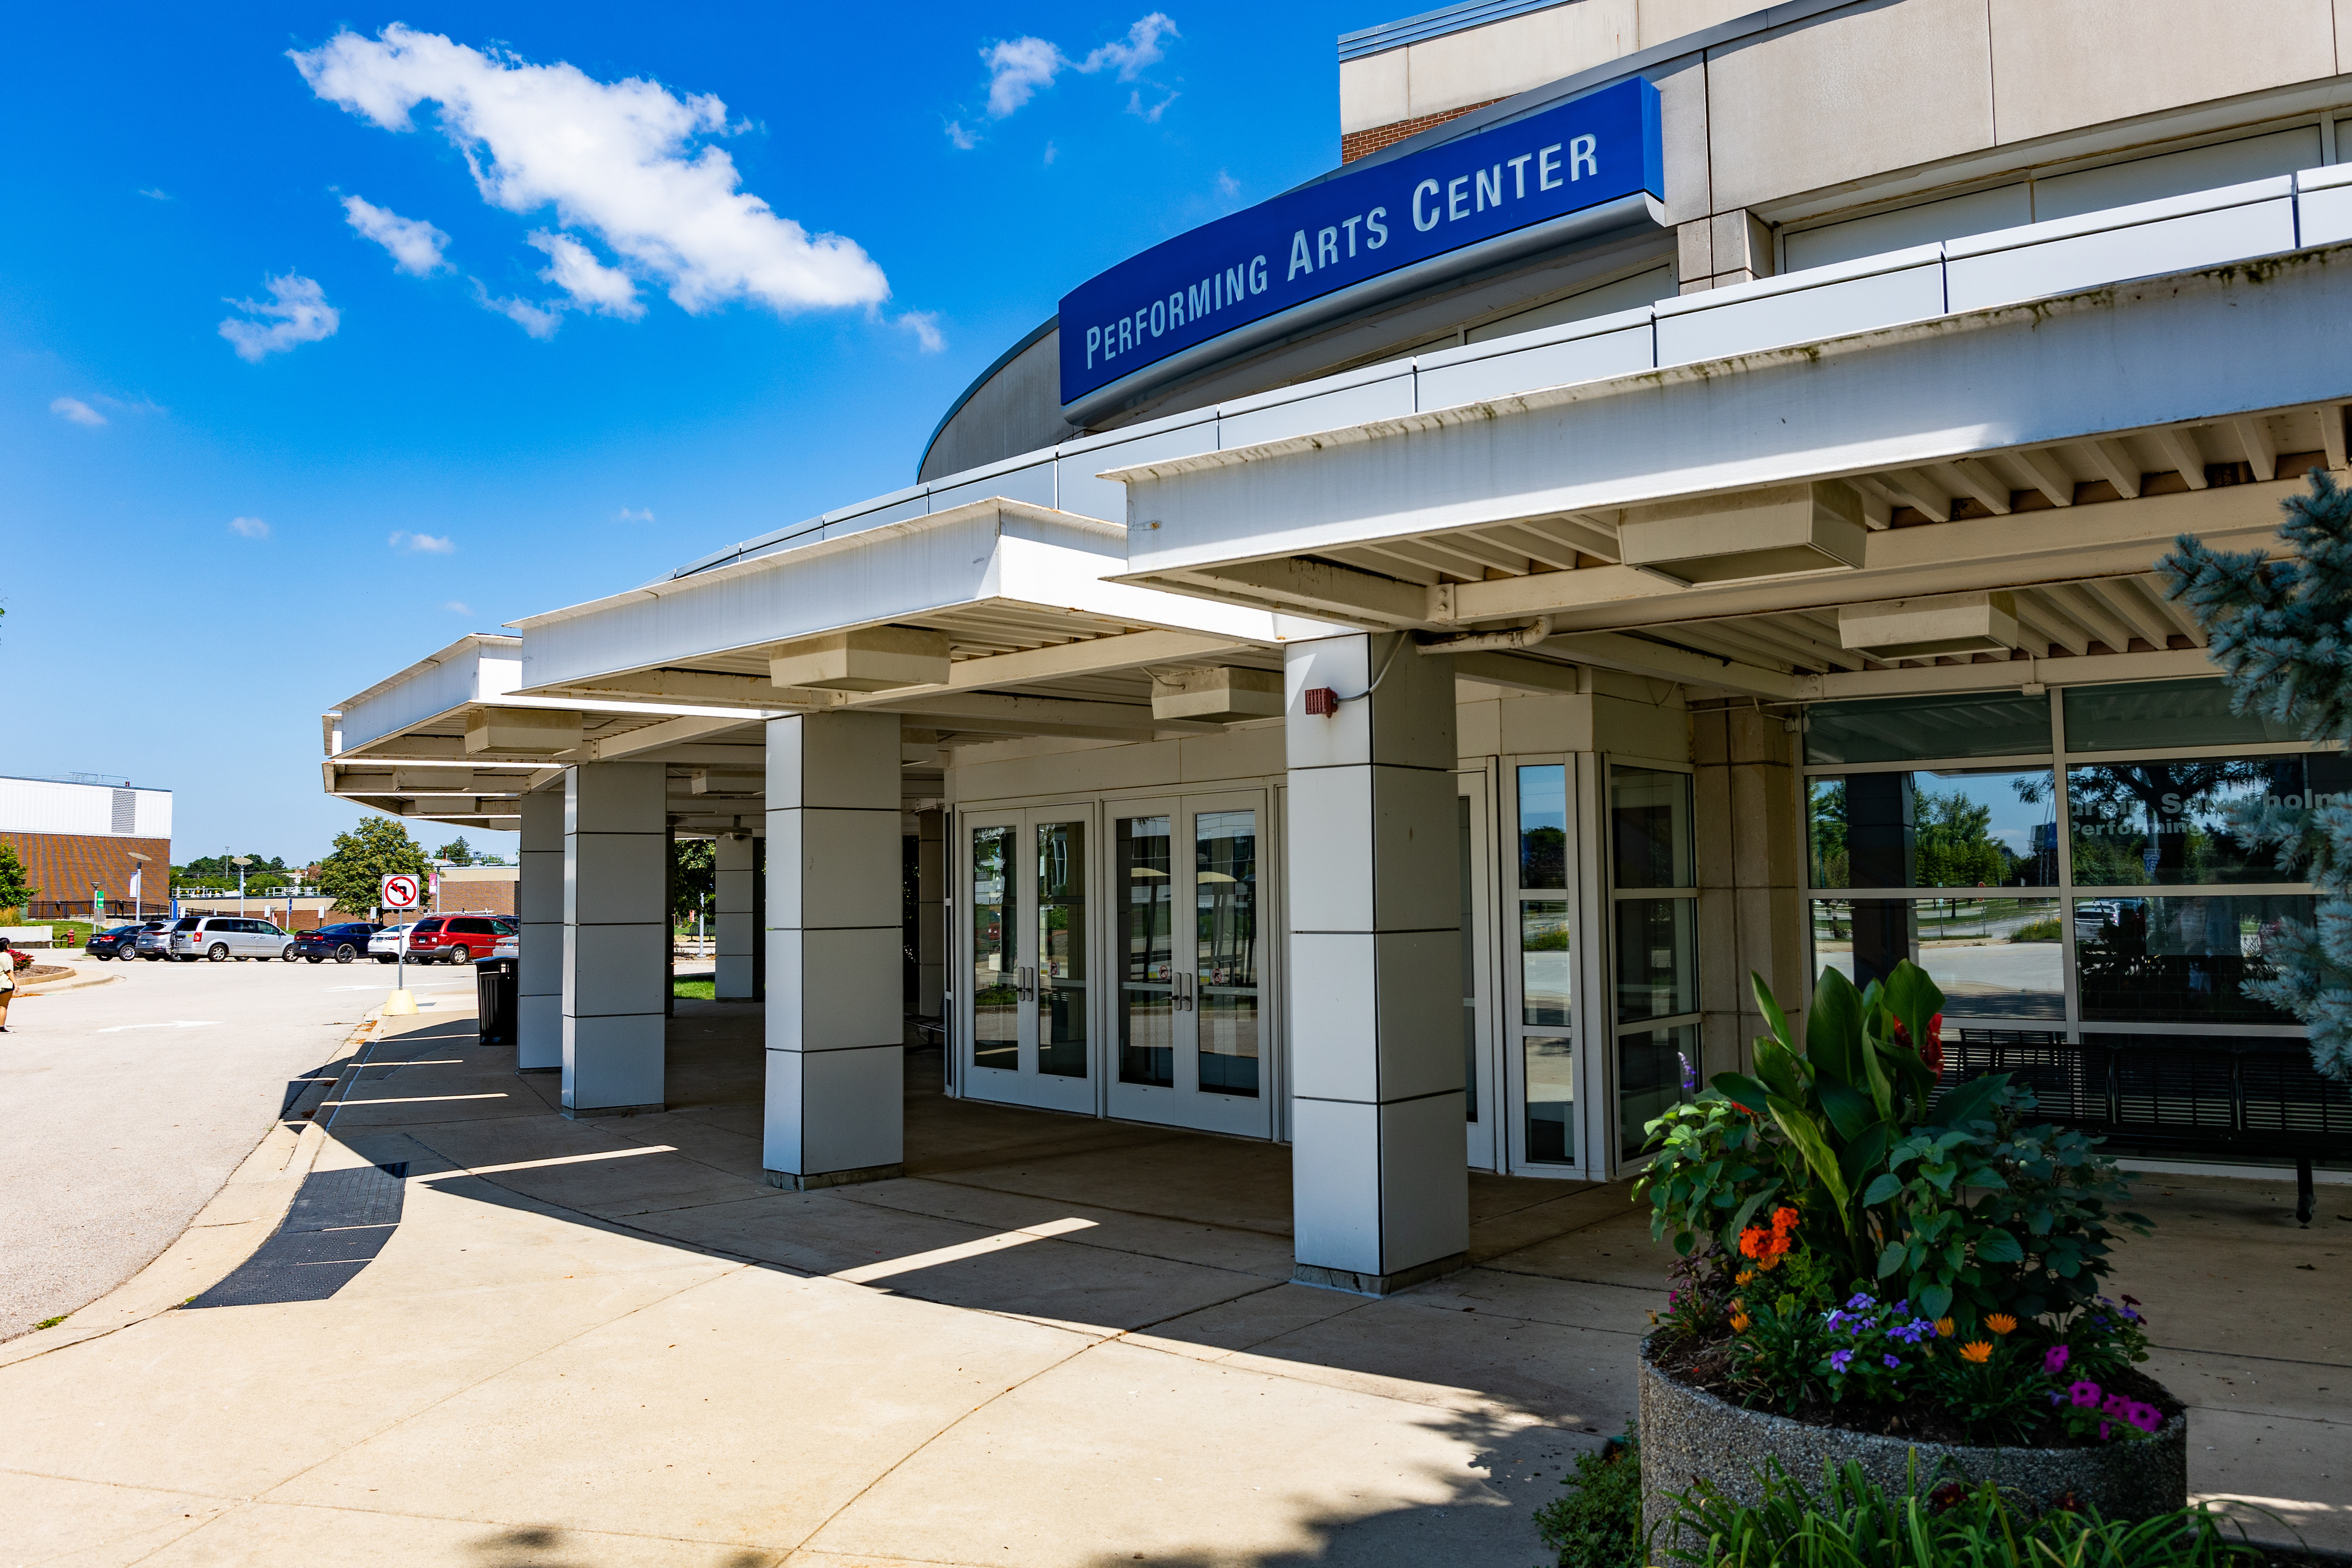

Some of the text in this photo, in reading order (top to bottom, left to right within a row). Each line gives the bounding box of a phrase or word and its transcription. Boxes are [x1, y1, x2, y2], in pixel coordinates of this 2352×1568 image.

[1086, 132, 1598, 370] PERFORMING ARTS CENTER
